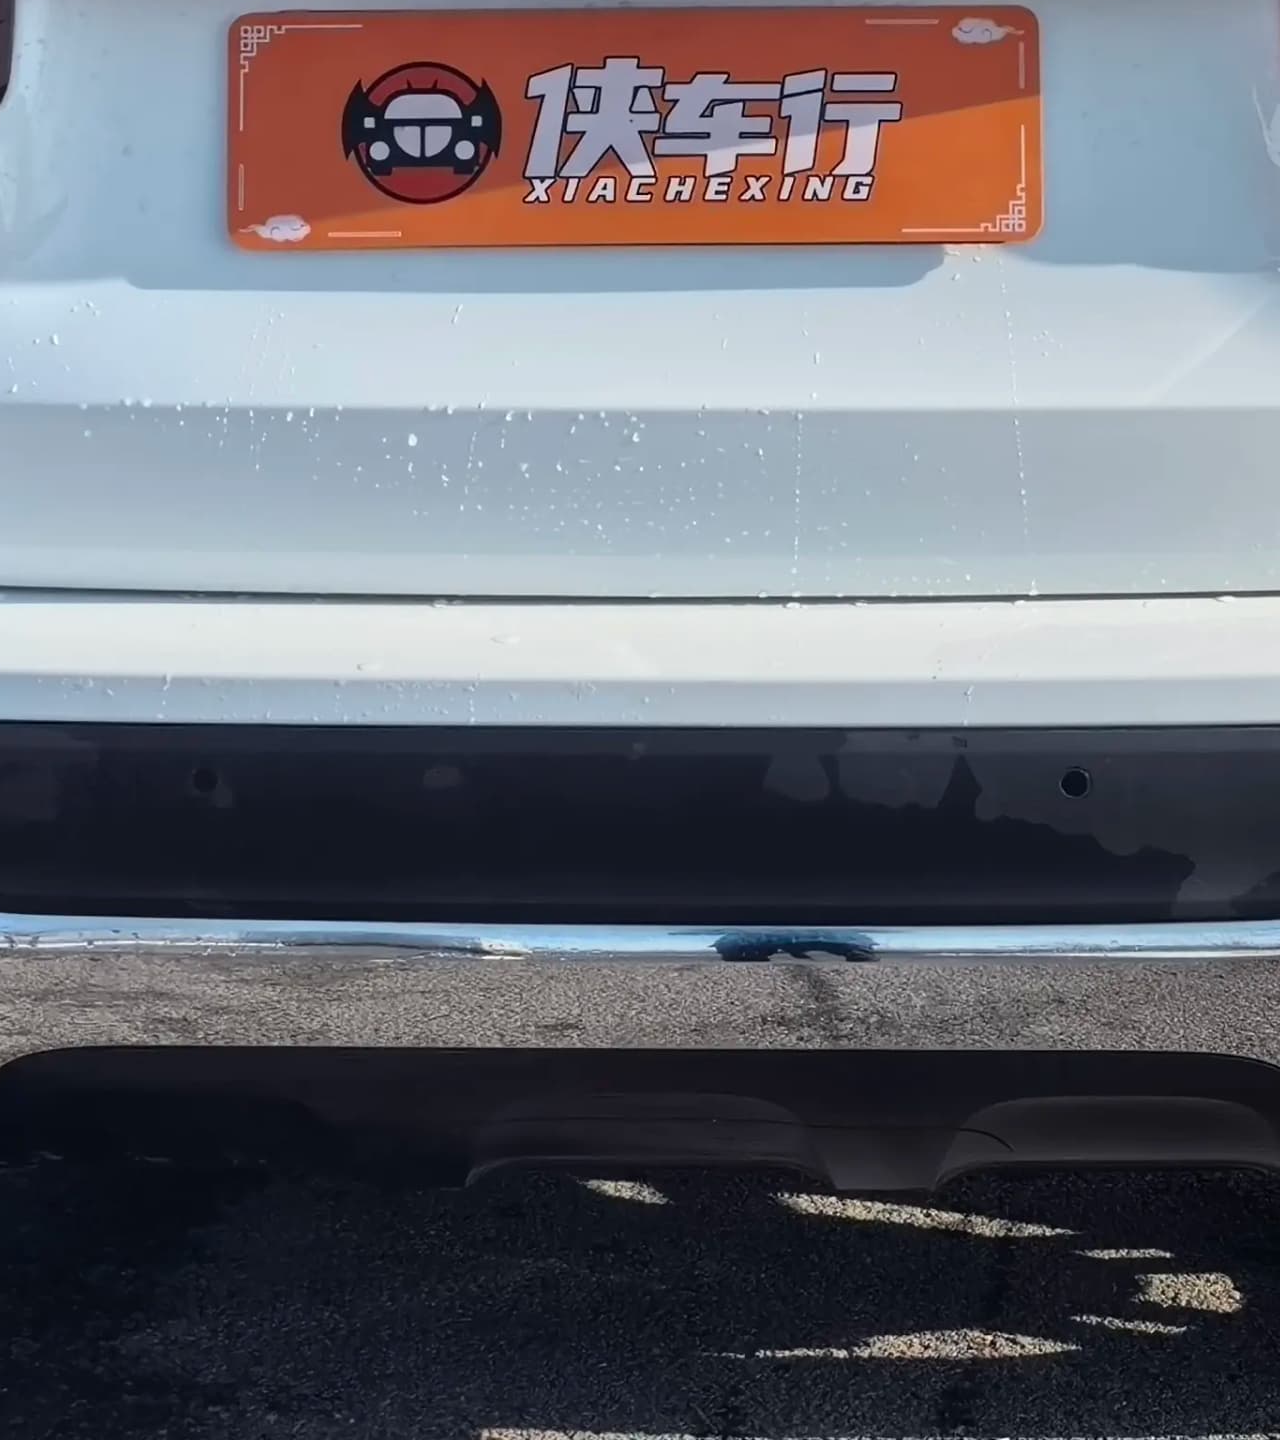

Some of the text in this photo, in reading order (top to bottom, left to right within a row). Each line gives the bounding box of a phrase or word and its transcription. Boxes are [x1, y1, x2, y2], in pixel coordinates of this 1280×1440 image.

[523, 56, 903, 178] 侠车行
[522, 175, 875, 203] XIACHEXING
